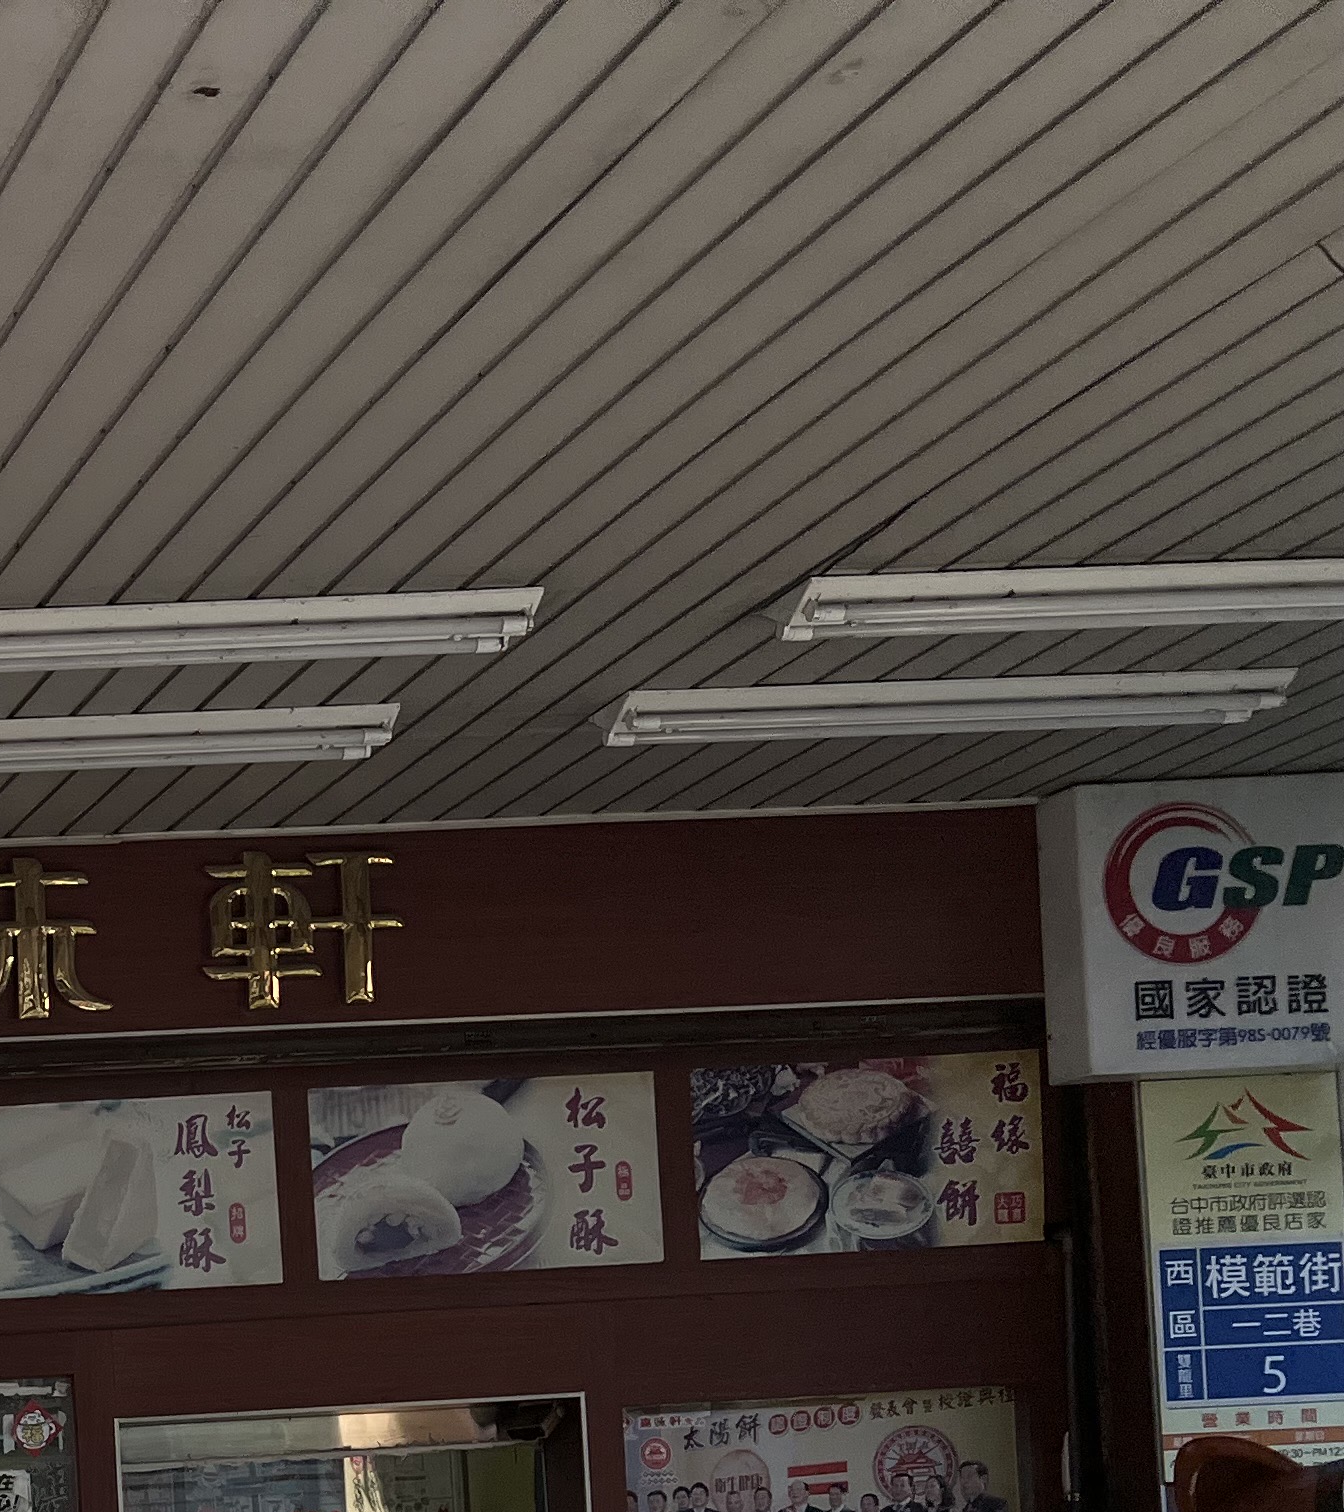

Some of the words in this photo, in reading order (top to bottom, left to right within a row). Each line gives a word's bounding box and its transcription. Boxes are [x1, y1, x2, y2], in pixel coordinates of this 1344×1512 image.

[1152, 843, 1344, 911] GSP
[1134, 973, 1330, 1022] 國家認證
[225, 1104, 251, 1169] 松子
[174, 1114, 227, 1273] 鳳梨酥
[565, 1087, 619, 1255] 松子酥
[1170, 1191, 1327, 1215] 台中市政府評選認
[1172, 1212, 1328, 1236] 證推薦優良店家
[1164, 1259, 1198, 1340] 西區
[1205, 1251, 1342, 1301] 模範街
[1231, 1308, 1322, 1339] 一二巷
[1261, 1354, 1288, 1395] 5
[22, 1425, 45, 1444] 福
[683, 1413, 761, 1450] 太陽餅
